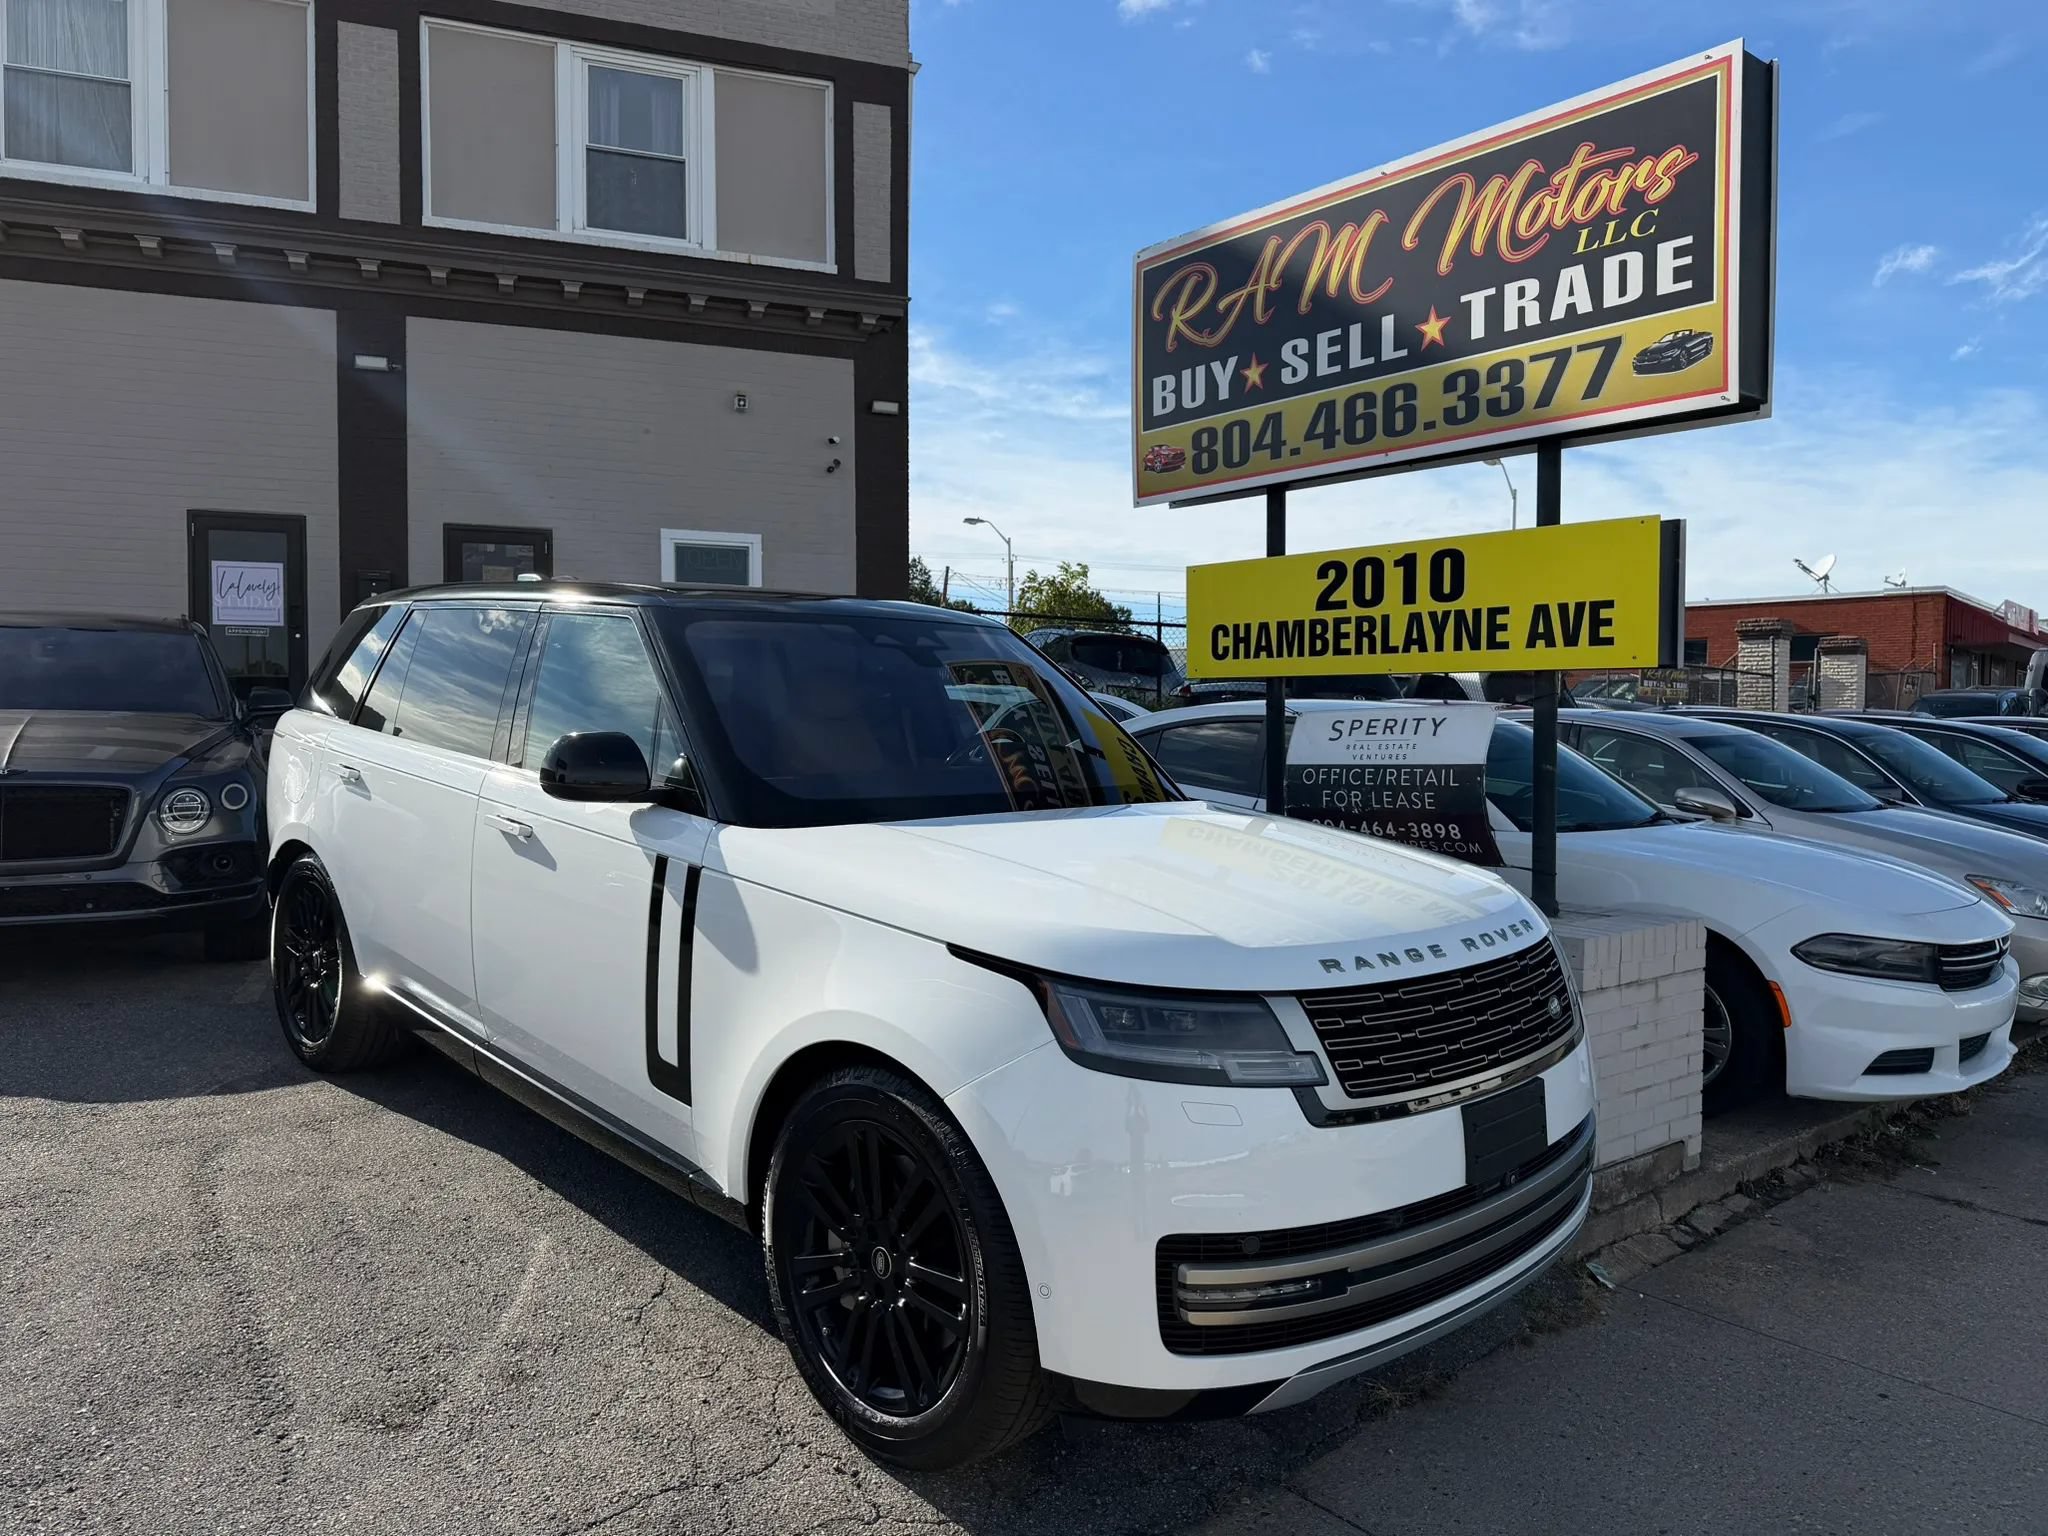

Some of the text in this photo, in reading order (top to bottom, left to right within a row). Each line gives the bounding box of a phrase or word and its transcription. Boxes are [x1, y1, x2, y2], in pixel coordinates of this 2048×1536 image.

[1152, 142, 1699, 352] RAM Motors
[1572, 208, 1660, 255] LLC
[1153, 235, 1693, 417] BUY SELL TRADE
[1191, 334, 1626, 476] 804.466.3377
[1315, 548, 1465, 611] 2010
[1211, 600, 1615, 661] CHAMBERLAYNE AVE
[1328, 717, 1447, 741] SPERITY
[1346, 743, 1371, 751] REAL
[1302, 767, 1460, 787] OFFICE/RETAIL
[1352, 753, 1408, 761] VENTURES
[1322, 790, 1436, 810] FOR LEASE
[1317, 918, 1534, 974] RANGE ROVER
